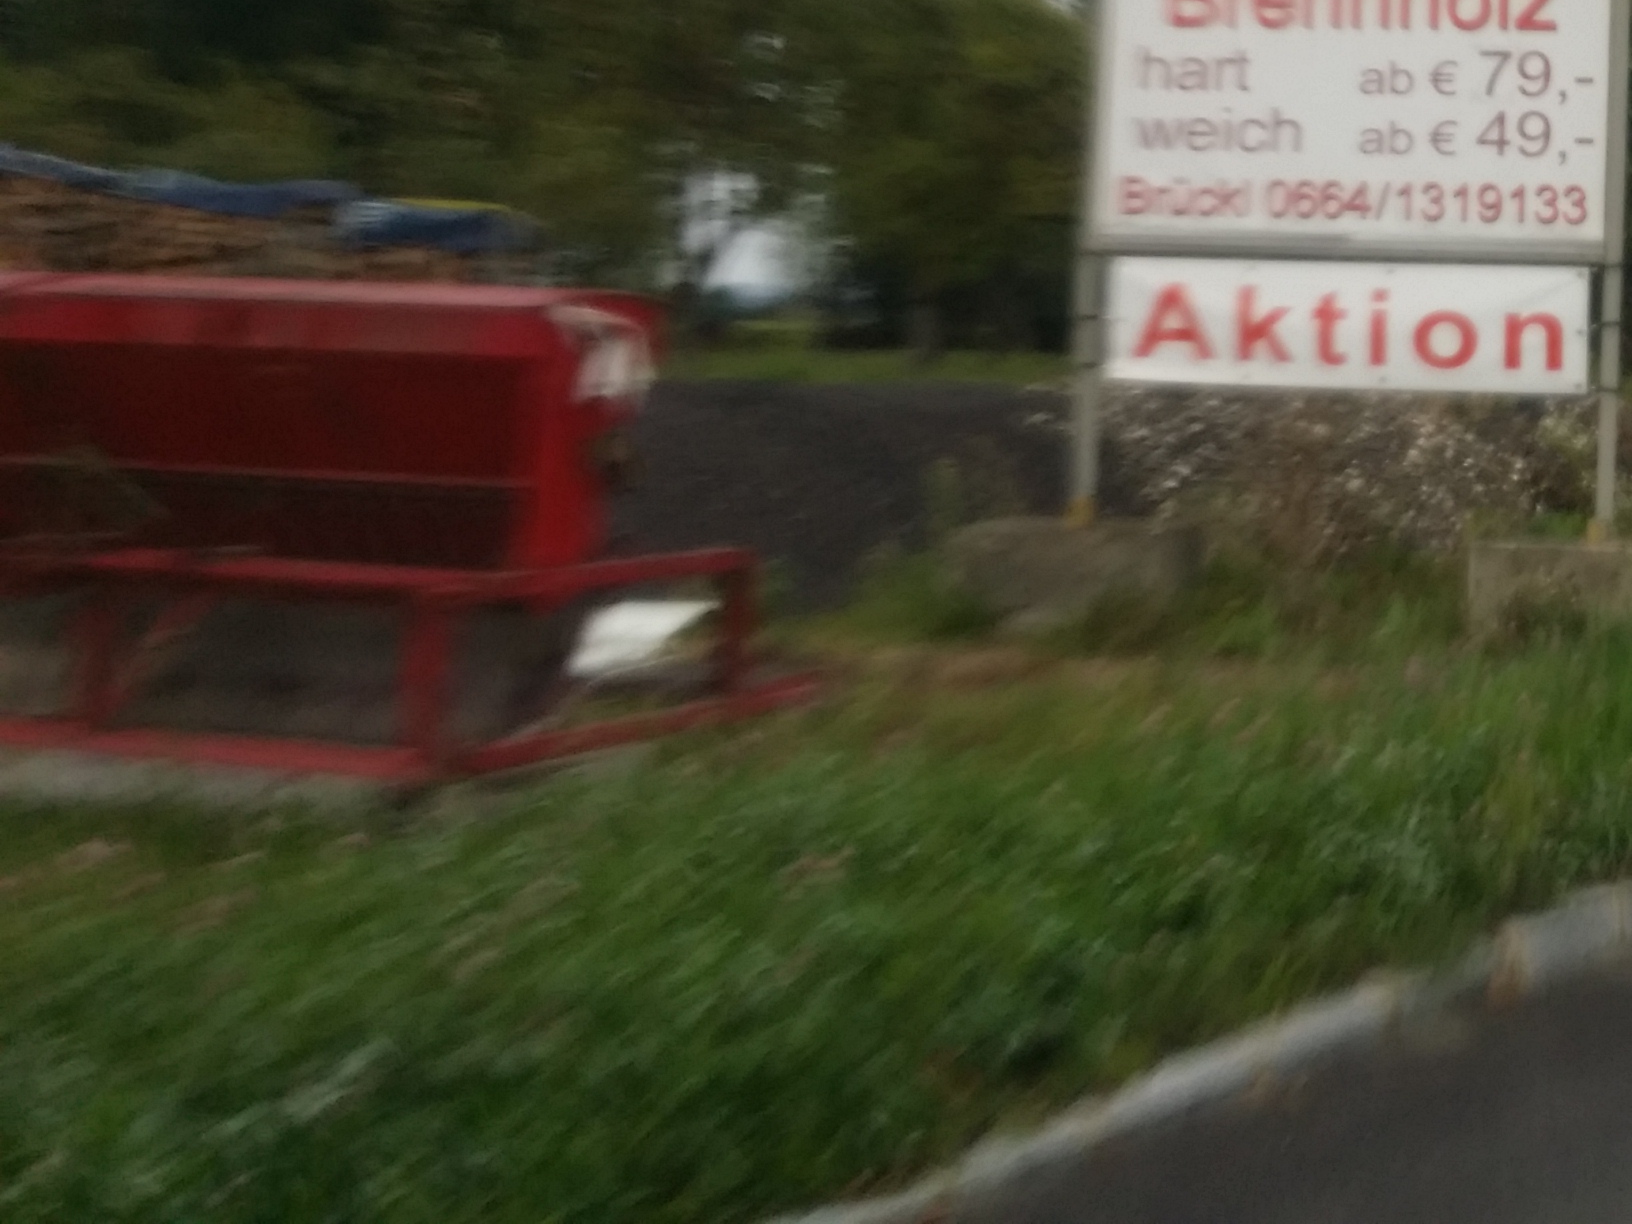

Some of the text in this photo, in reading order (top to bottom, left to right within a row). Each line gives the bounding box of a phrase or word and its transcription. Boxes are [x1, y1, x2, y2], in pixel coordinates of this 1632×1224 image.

[1135, 45, 1250, 92] hart
[1358, 61, 1415, 96] ab
[1429, 60, 1458, 96] €
[1132, 107, 1303, 154] weich
[1358, 121, 1415, 156] ab
[1429, 121, 1458, 156] €
[1265, 179, 1588, 225] 0664/1319133
[1131, 282, 1564, 371] Aktion
